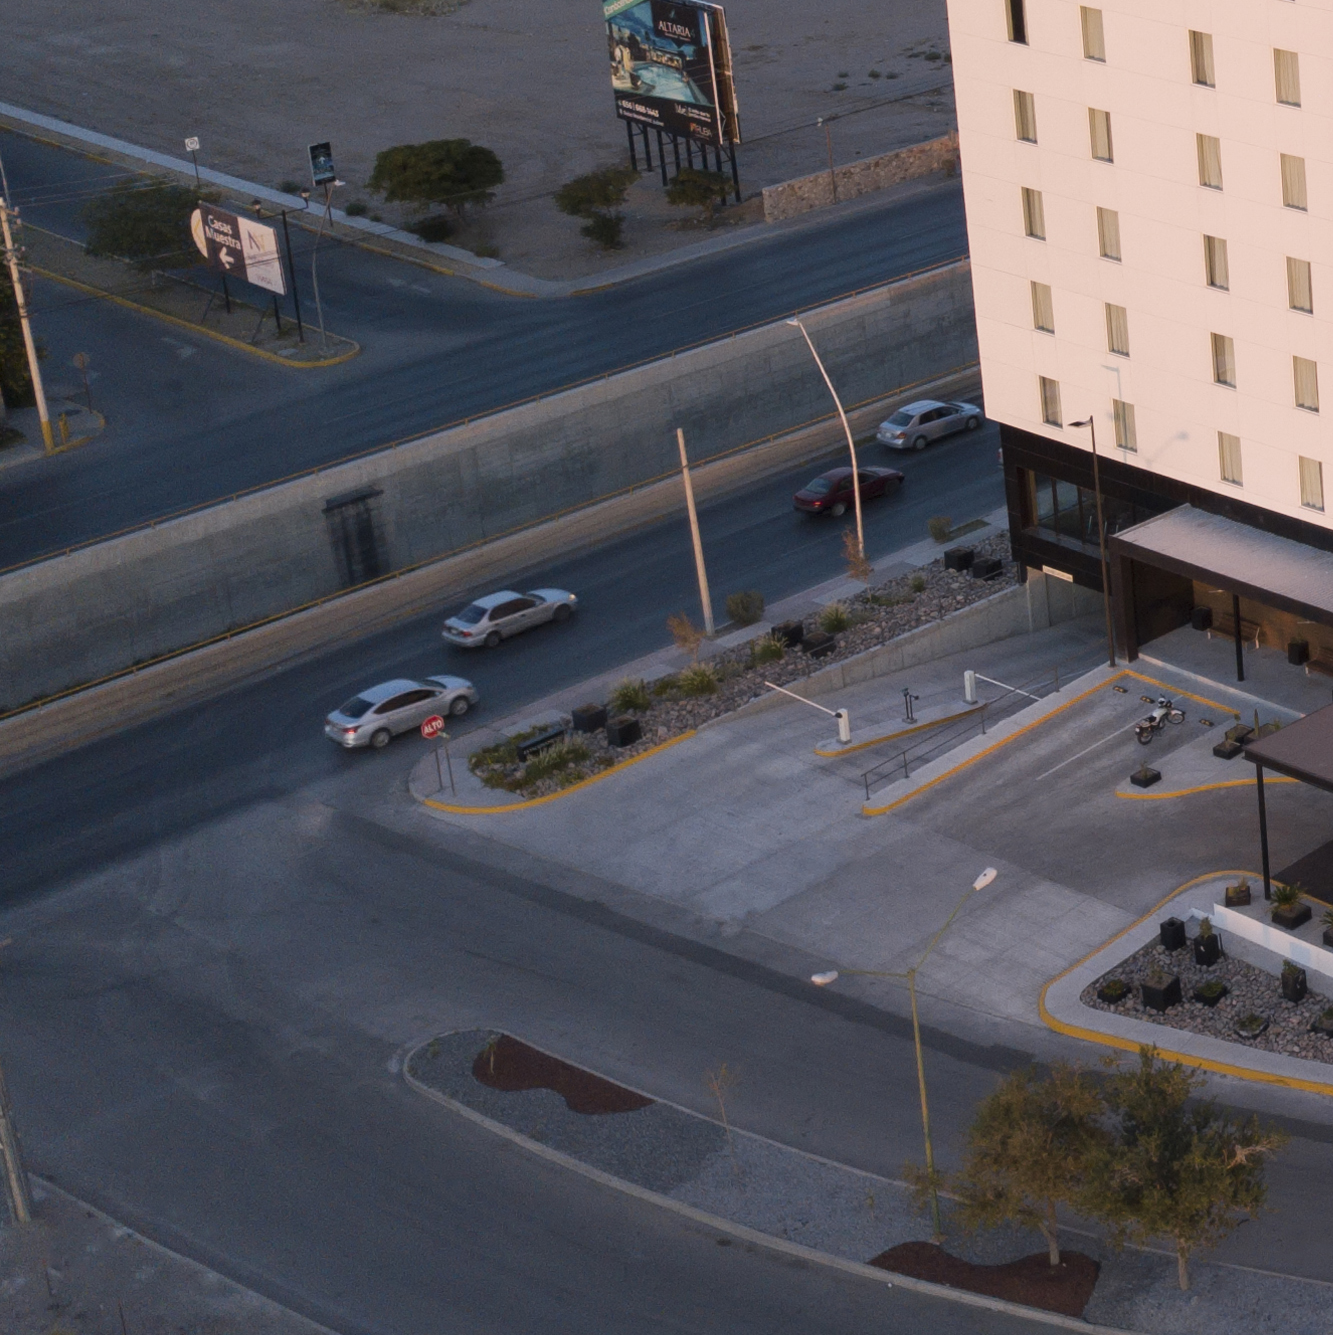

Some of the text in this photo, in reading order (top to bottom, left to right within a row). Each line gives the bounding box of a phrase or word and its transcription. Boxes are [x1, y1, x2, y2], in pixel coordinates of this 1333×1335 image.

[658, 20, 691, 38] ALTARIA
[207, 214, 232, 234] Casas
[205, 225, 242, 250] Muestra
[424, 719, 443, 735] ALTO
